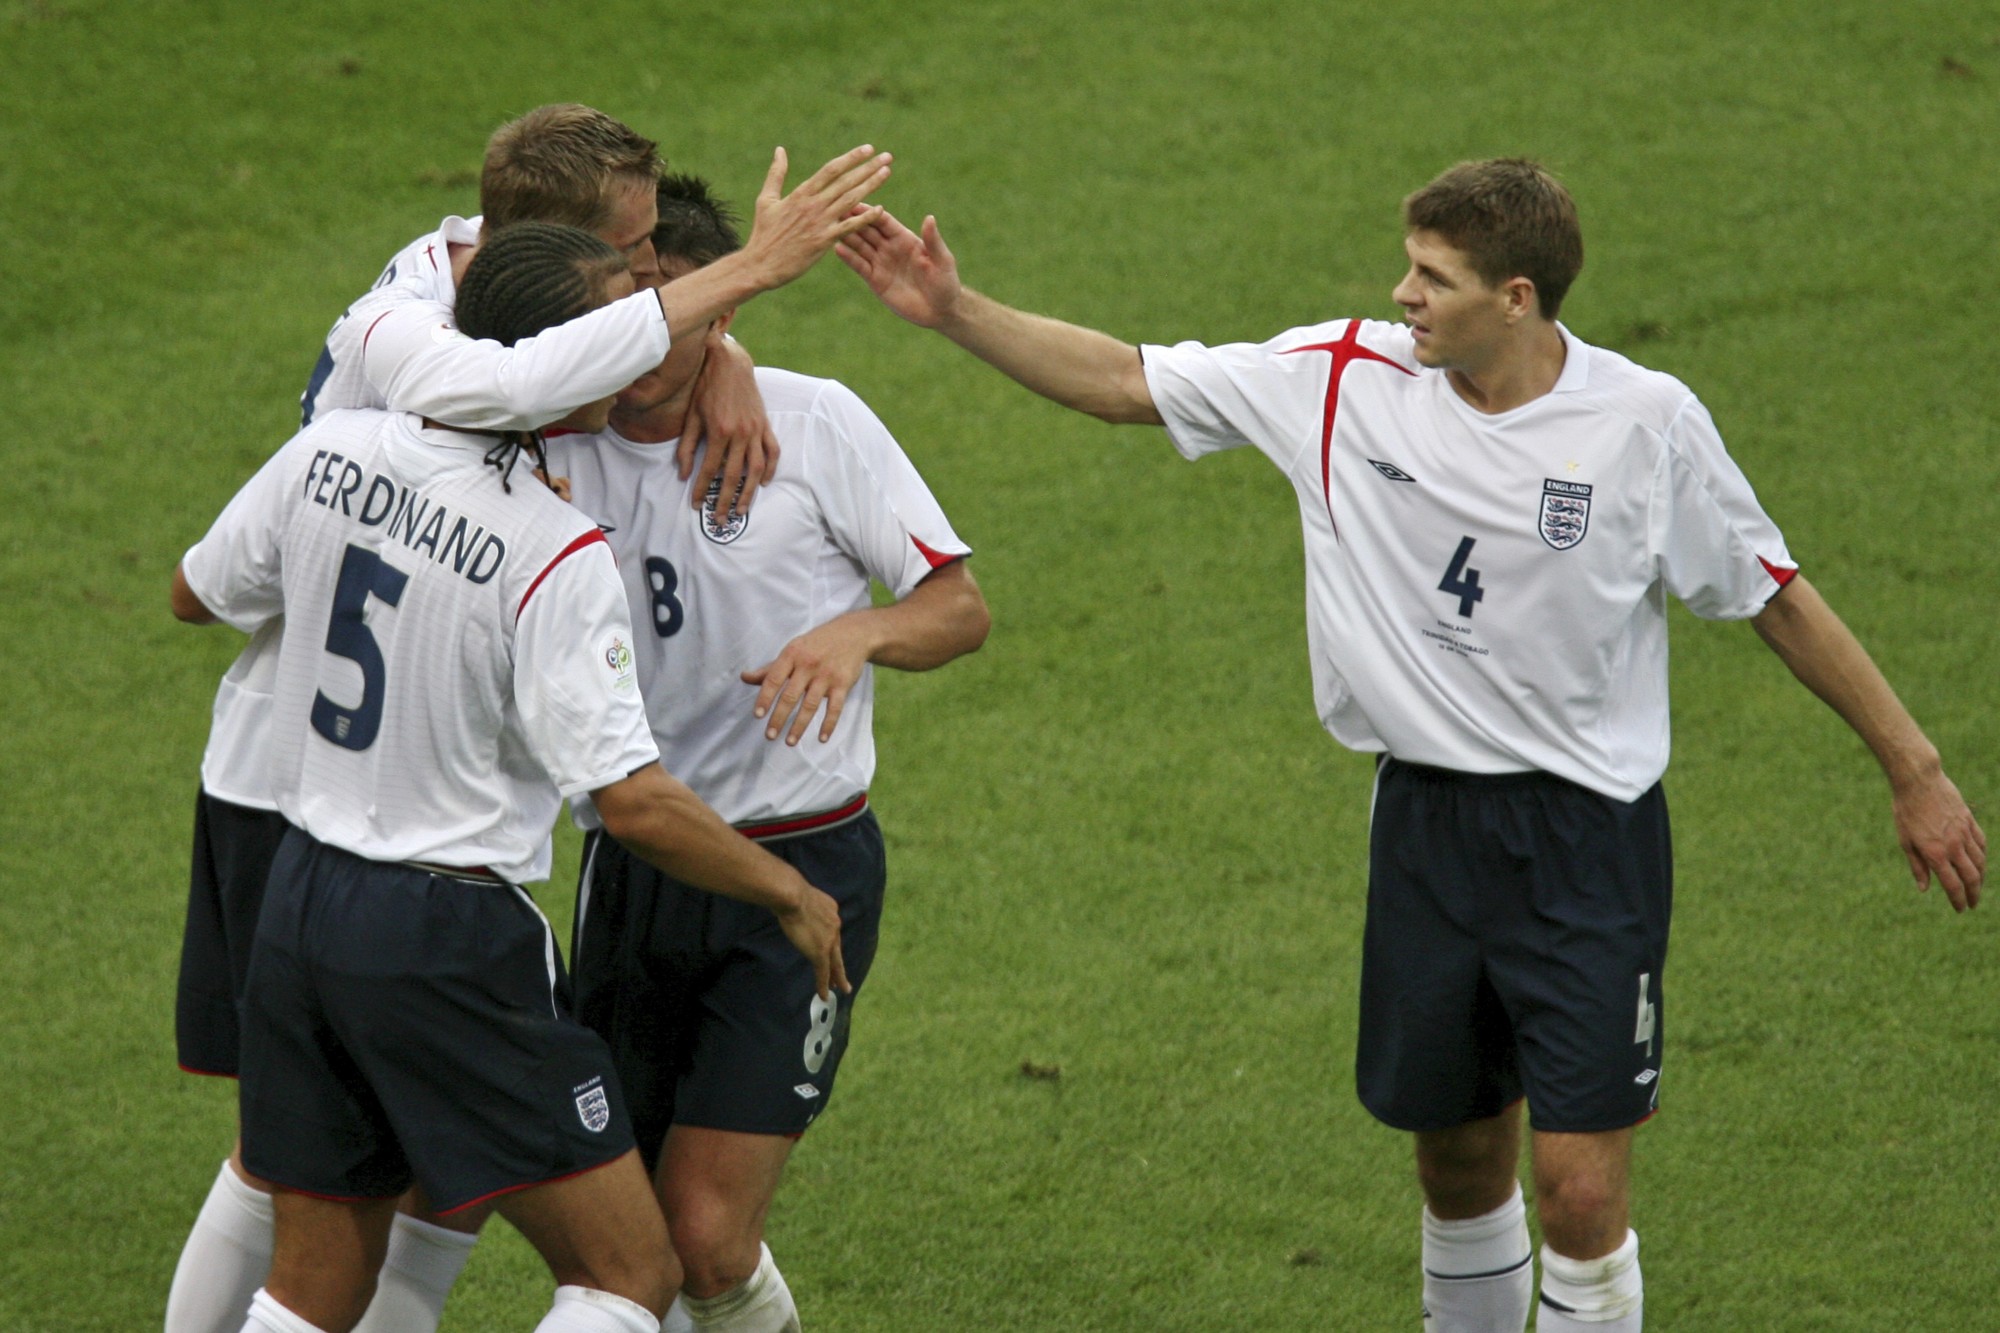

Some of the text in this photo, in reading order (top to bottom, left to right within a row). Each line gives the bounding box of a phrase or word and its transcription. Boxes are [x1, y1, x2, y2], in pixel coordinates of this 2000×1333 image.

[303, 449, 506, 585] FERDINAND
[1546, 480, 1590, 495] ENGLAND
[645, 556, 684, 638] 8
[1437, 535, 1484, 618] 4
[310, 542, 410, 751] 5
[803, 989, 837, 1074] 8
[1634, 973, 1656, 1058] 4
